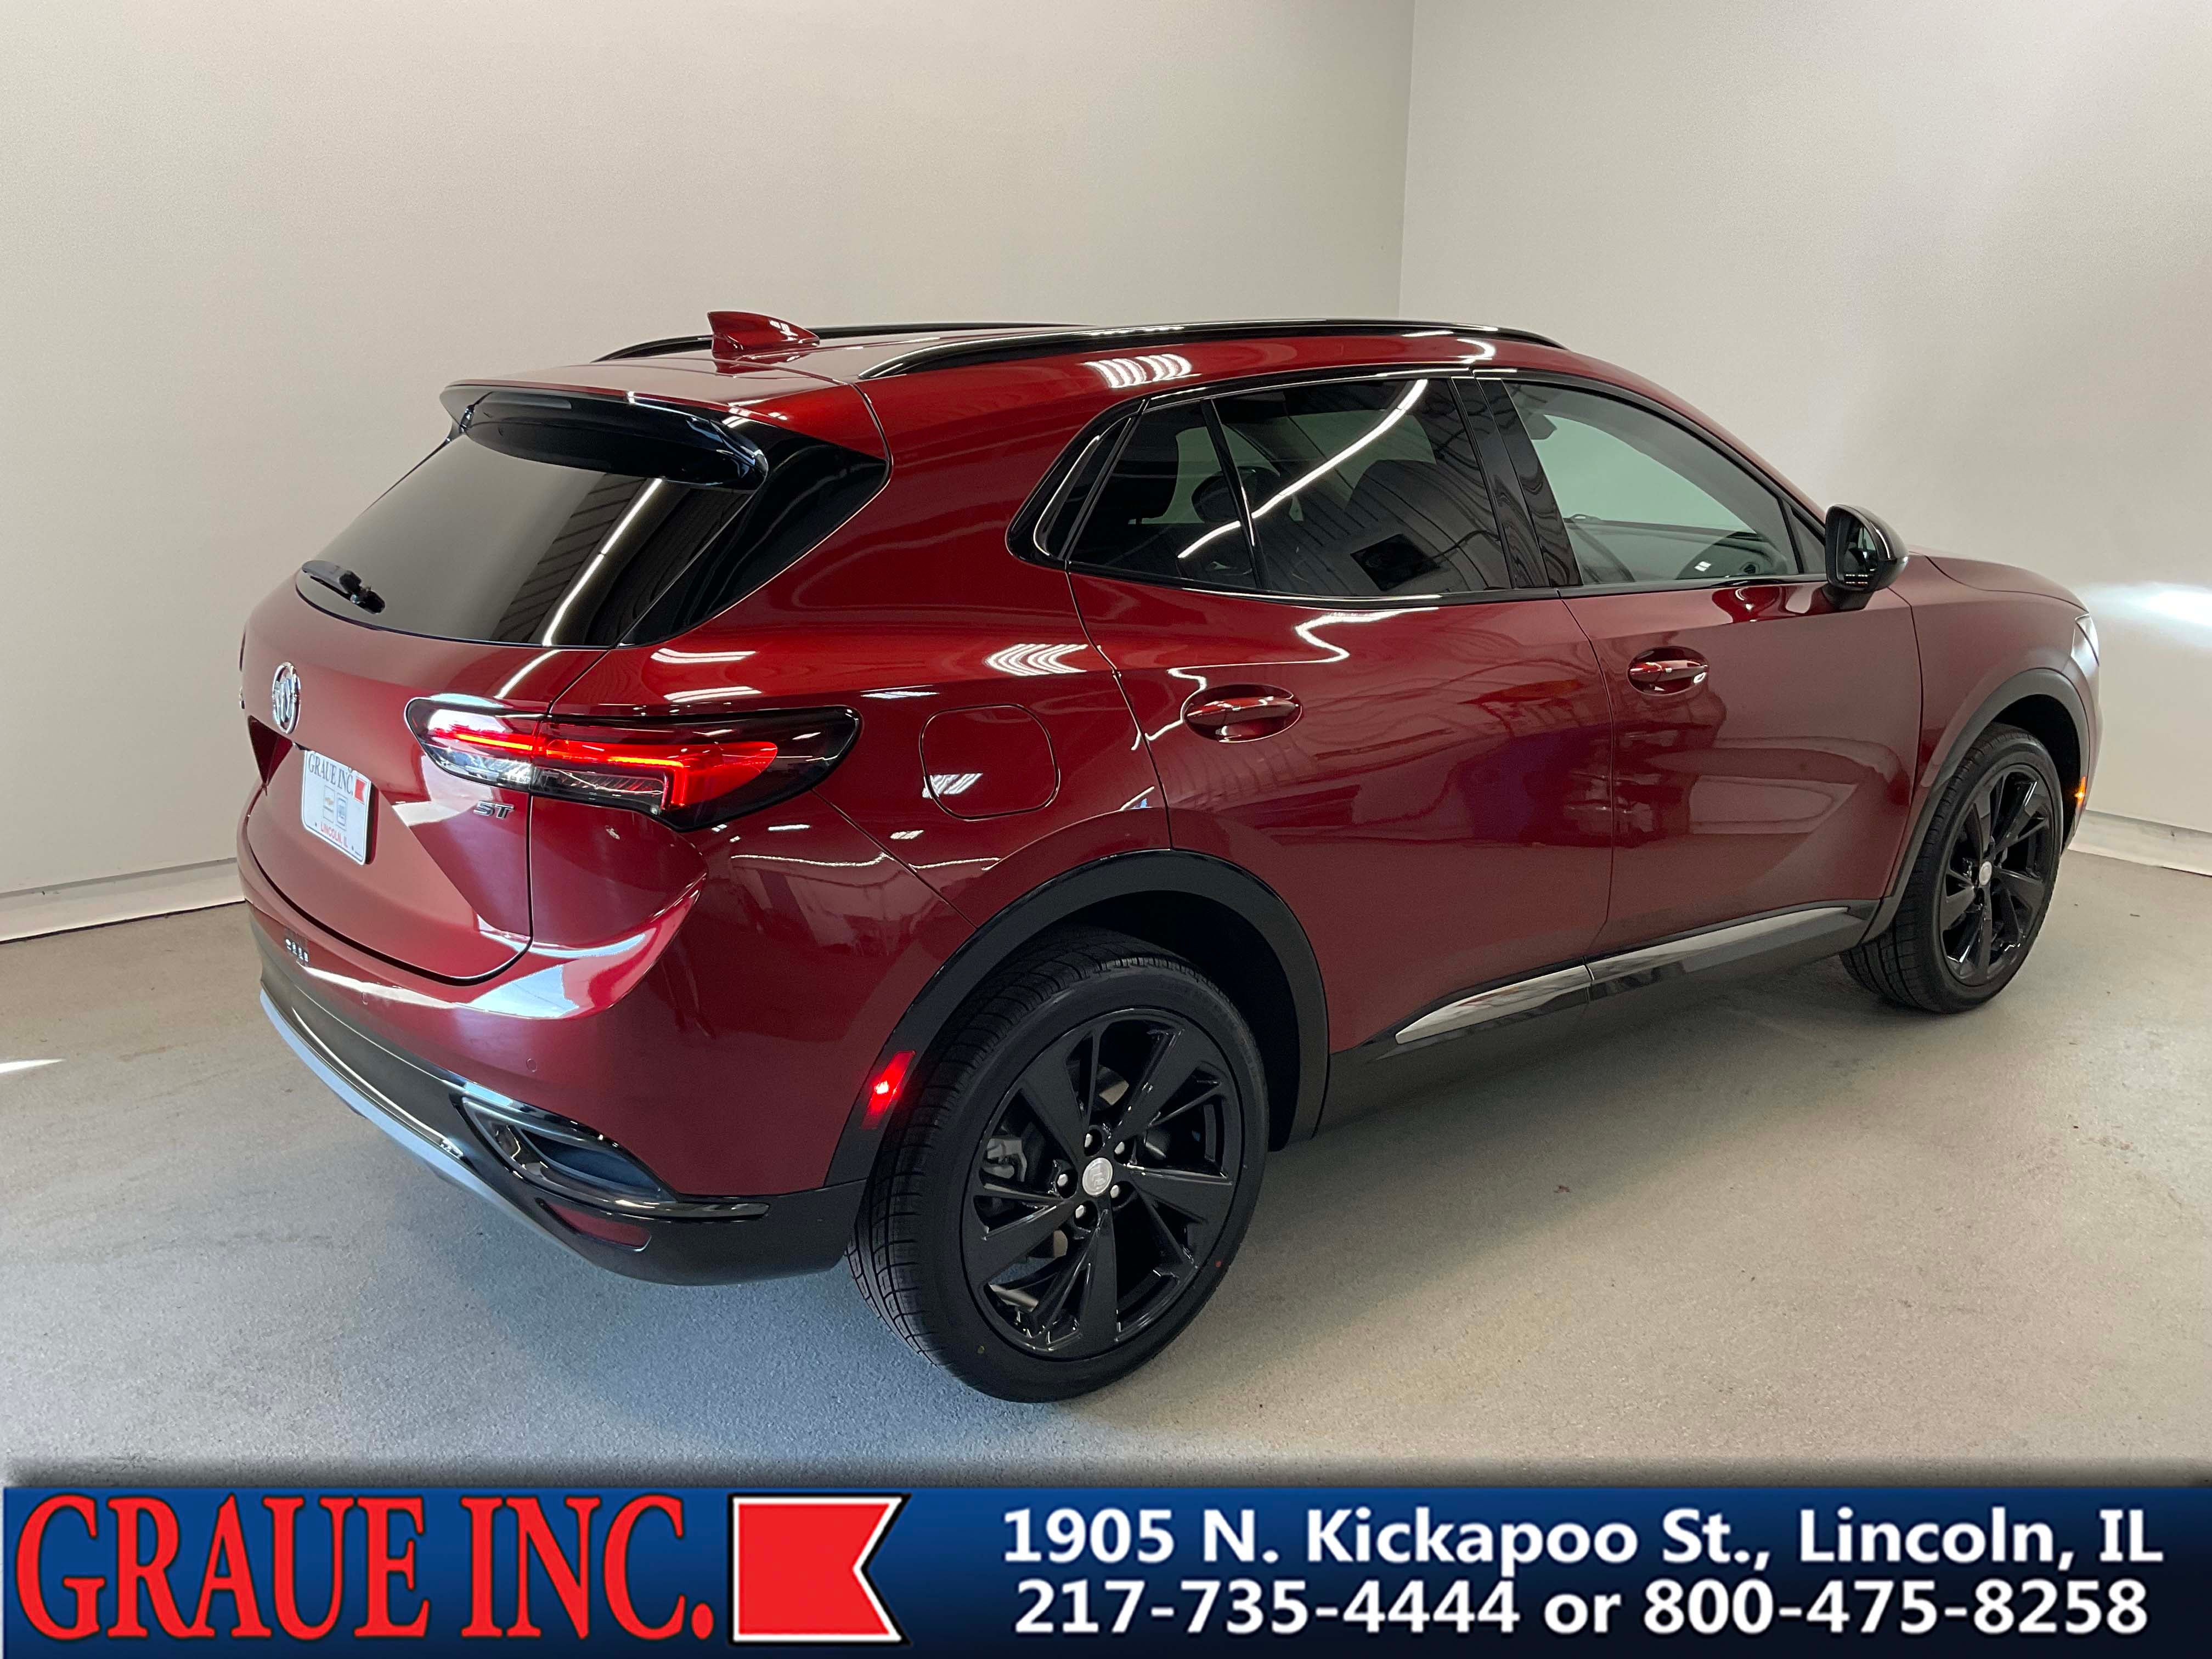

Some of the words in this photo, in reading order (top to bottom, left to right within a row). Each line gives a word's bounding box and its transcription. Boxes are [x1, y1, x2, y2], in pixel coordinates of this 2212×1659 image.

[308, 753, 336, 785] GRAUE
[337, 772, 353, 795] INC.
[473, 800, 515, 820] ST
[321, 822, 342, 845] LINCOLN,
[343, 836, 348, 848] IL
